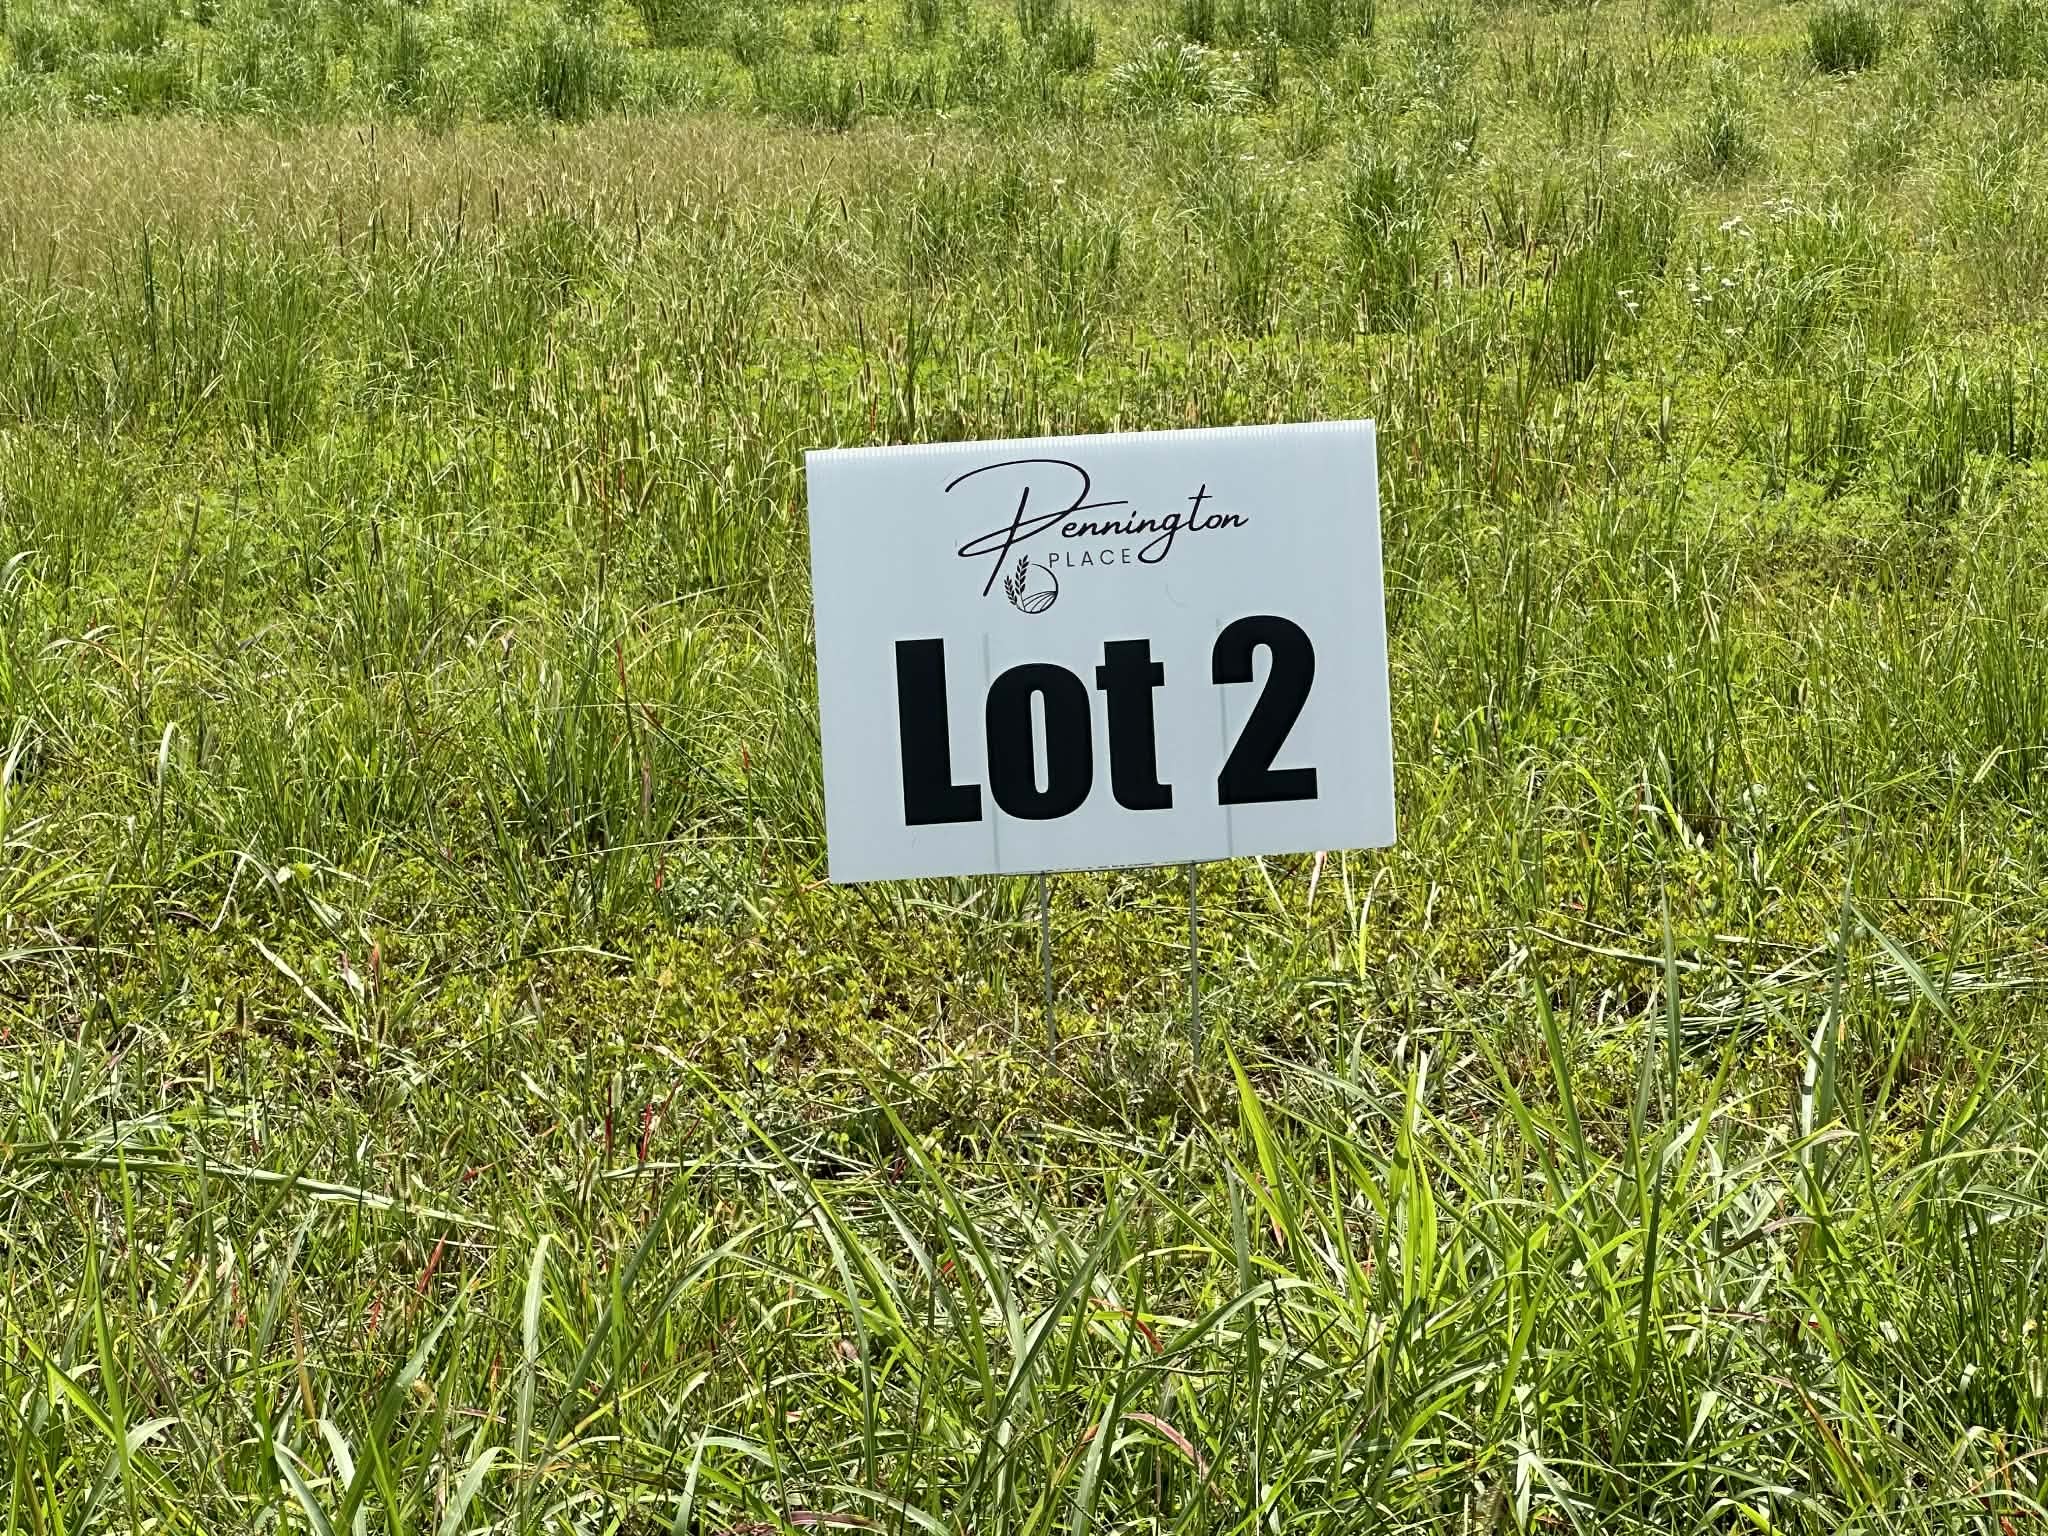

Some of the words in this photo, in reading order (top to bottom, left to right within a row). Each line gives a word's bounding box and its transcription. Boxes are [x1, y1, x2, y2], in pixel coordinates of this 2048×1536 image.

[944, 459, 1249, 597] Pennington
[1048, 548, 1131, 570] PLACE
[895, 638, 1174, 827] Lot
[1211, 615, 1319, 806] 2
